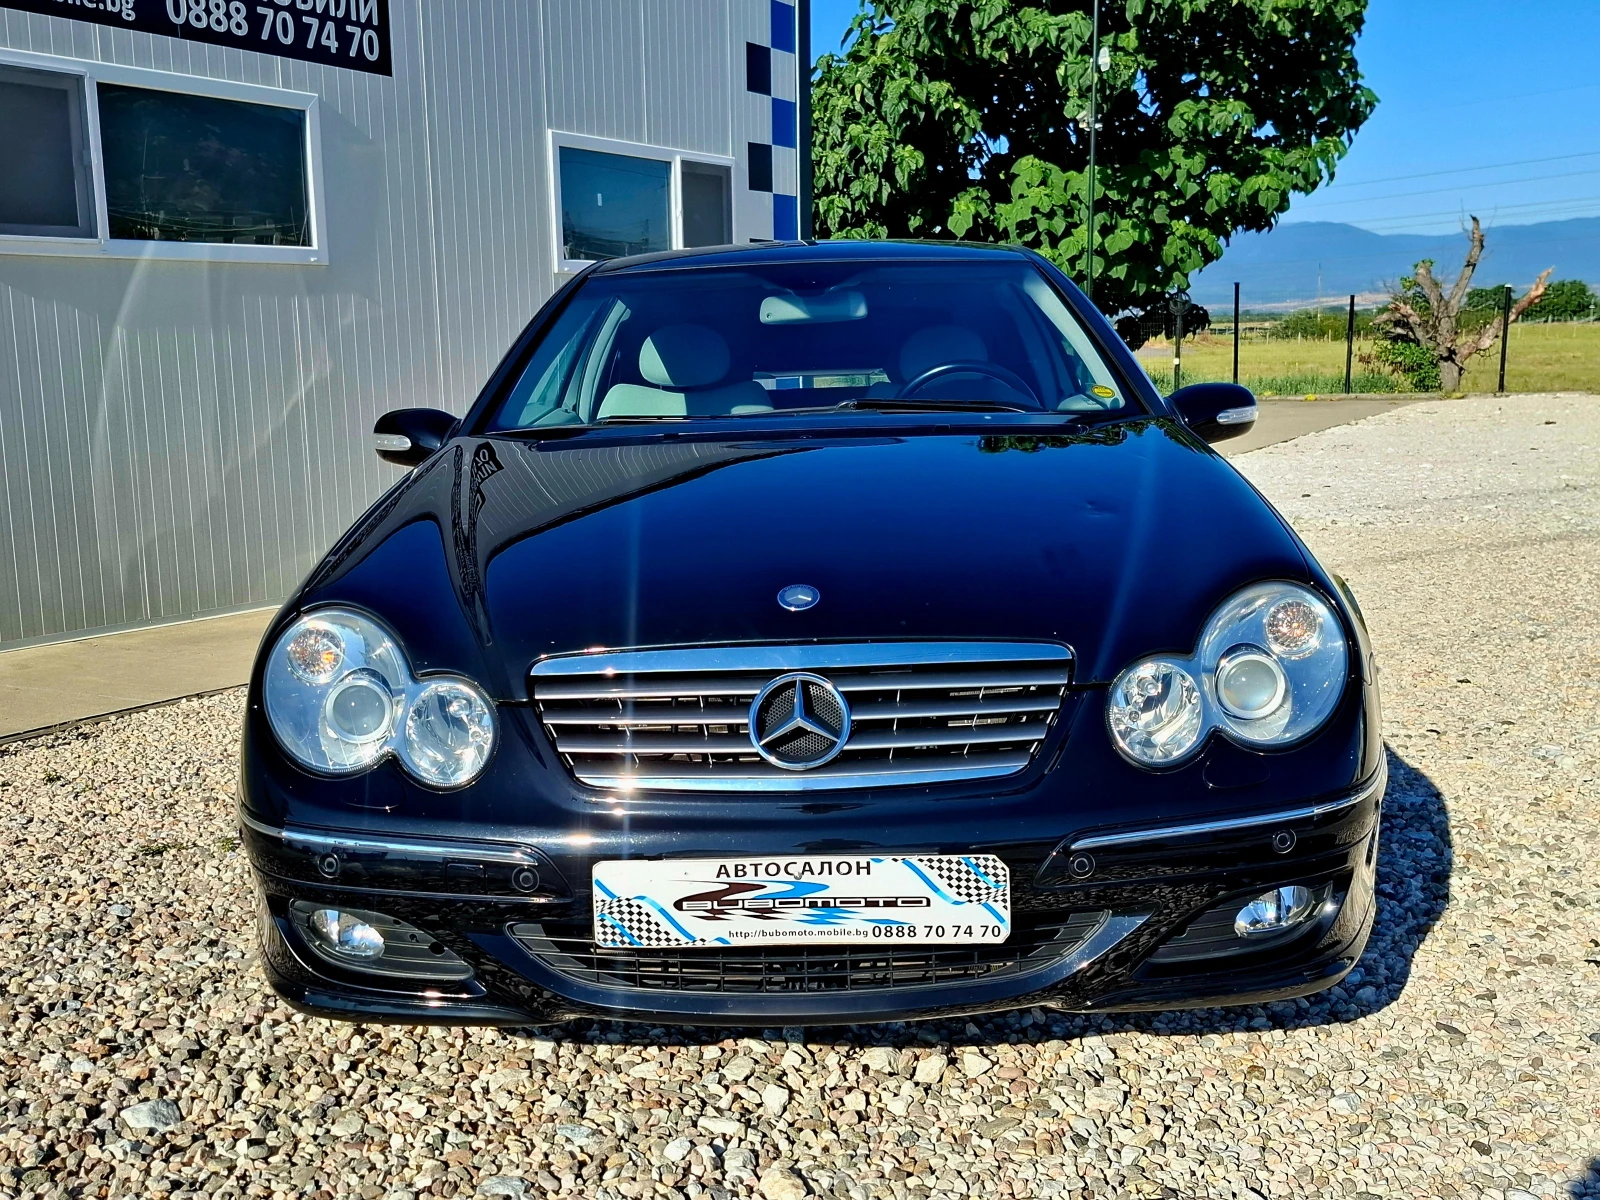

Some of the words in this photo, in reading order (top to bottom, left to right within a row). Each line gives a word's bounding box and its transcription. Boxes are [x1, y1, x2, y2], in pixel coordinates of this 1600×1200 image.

[166, 0, 249, 36] 0888
[256, 6, 295, 45] 70
[302, 15, 339, 54] 74
[345, 25, 380, 62] 70
[715, 861, 871, 878] АВТОСАЛОН
[728, 928, 869, 940] http://bubomoto.mobile.bg
[872, 925, 918, 938] 0888
[923, 925, 946, 938] 70
[952, 925, 974, 938] 74
[980, 925, 1002, 938] 70
